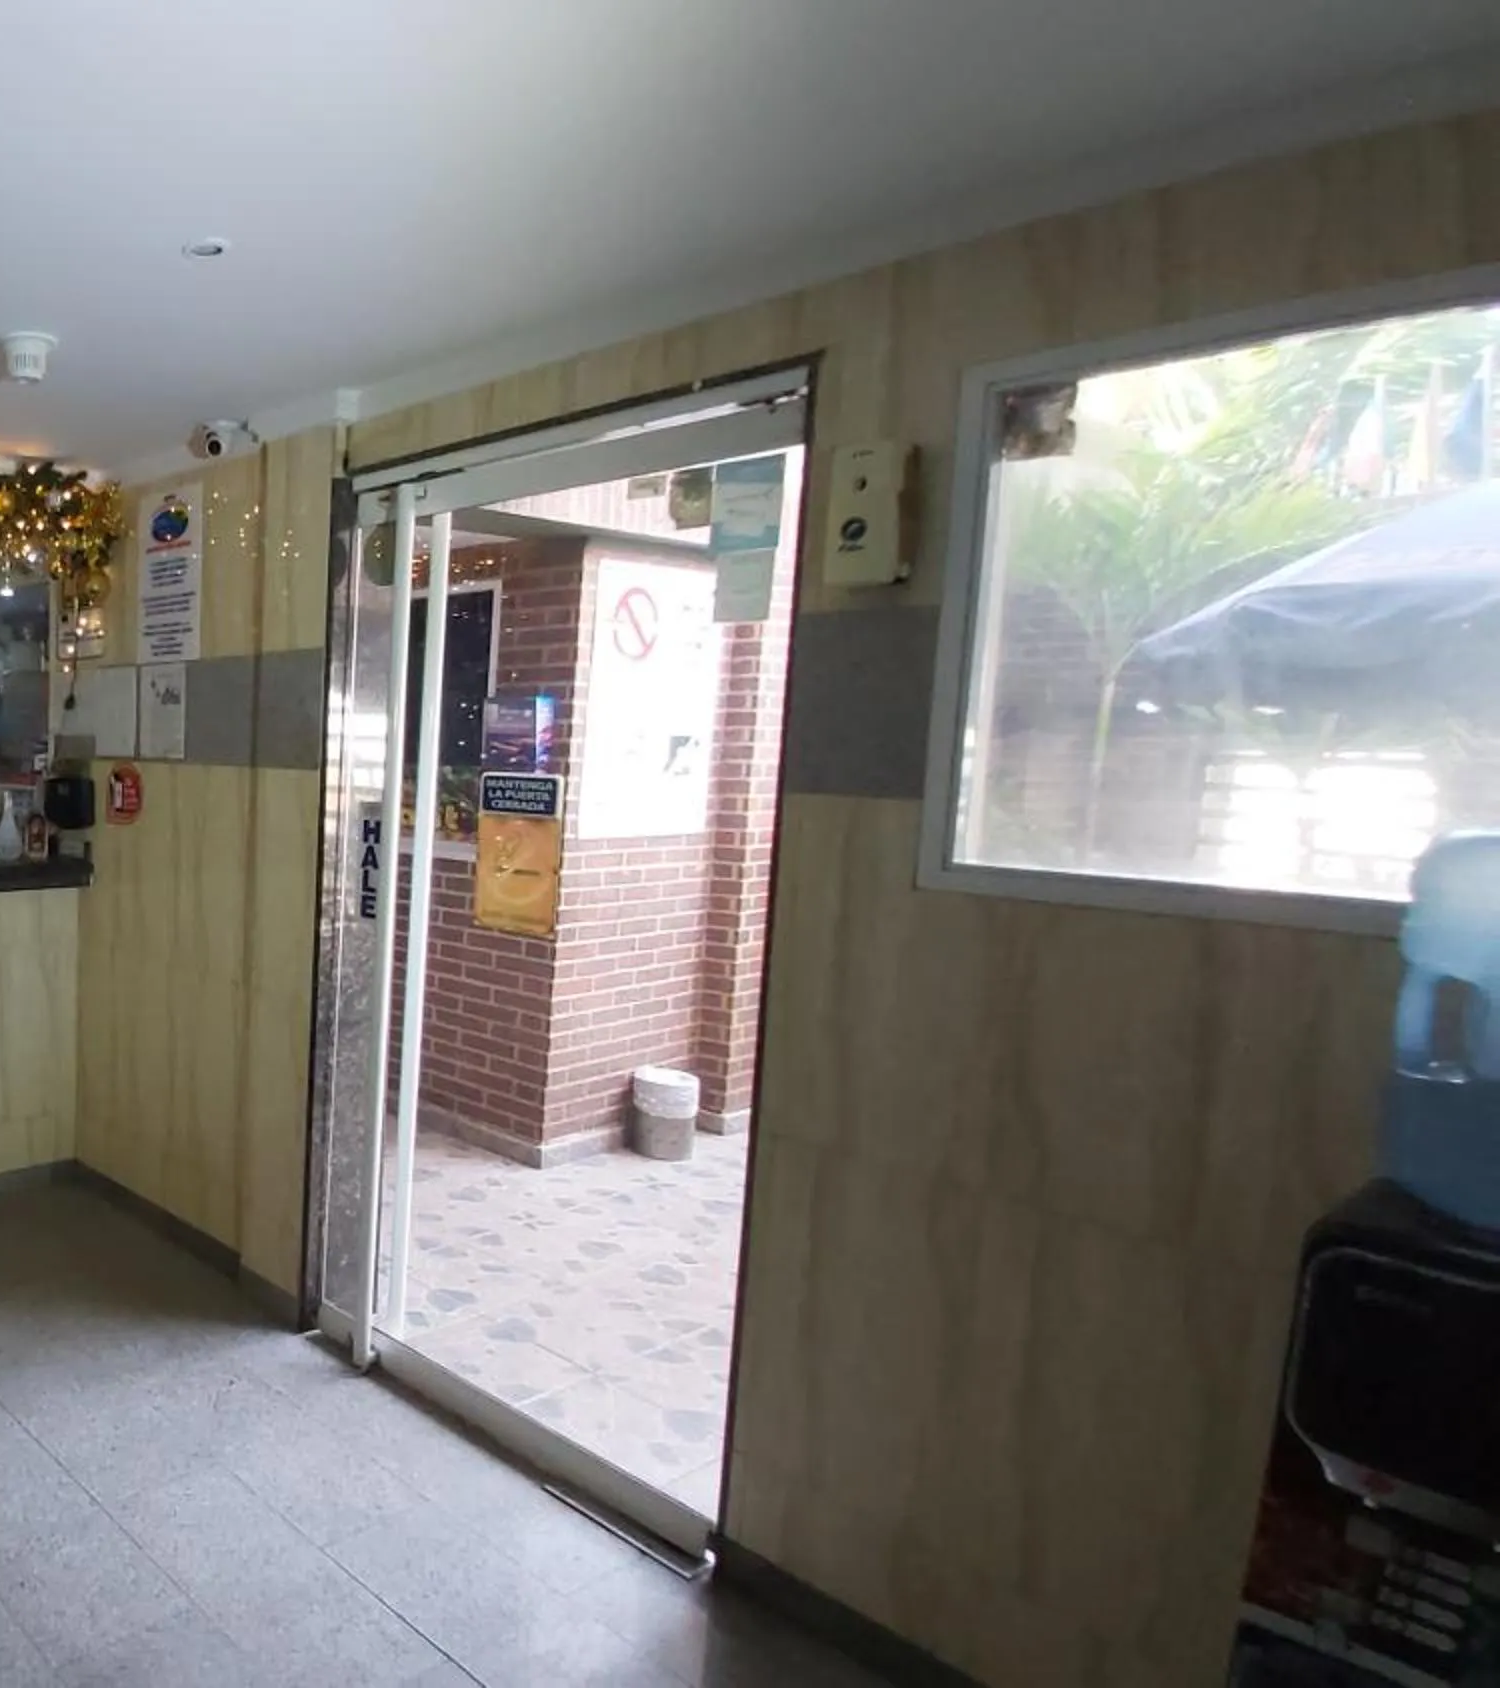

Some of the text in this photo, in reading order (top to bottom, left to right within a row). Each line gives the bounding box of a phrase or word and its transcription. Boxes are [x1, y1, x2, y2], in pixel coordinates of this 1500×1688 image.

[486, 779, 553, 791] MANTENGA
[488, 789, 550, 801] LA PUERTA
[360, 819, 381, 919] HALE
